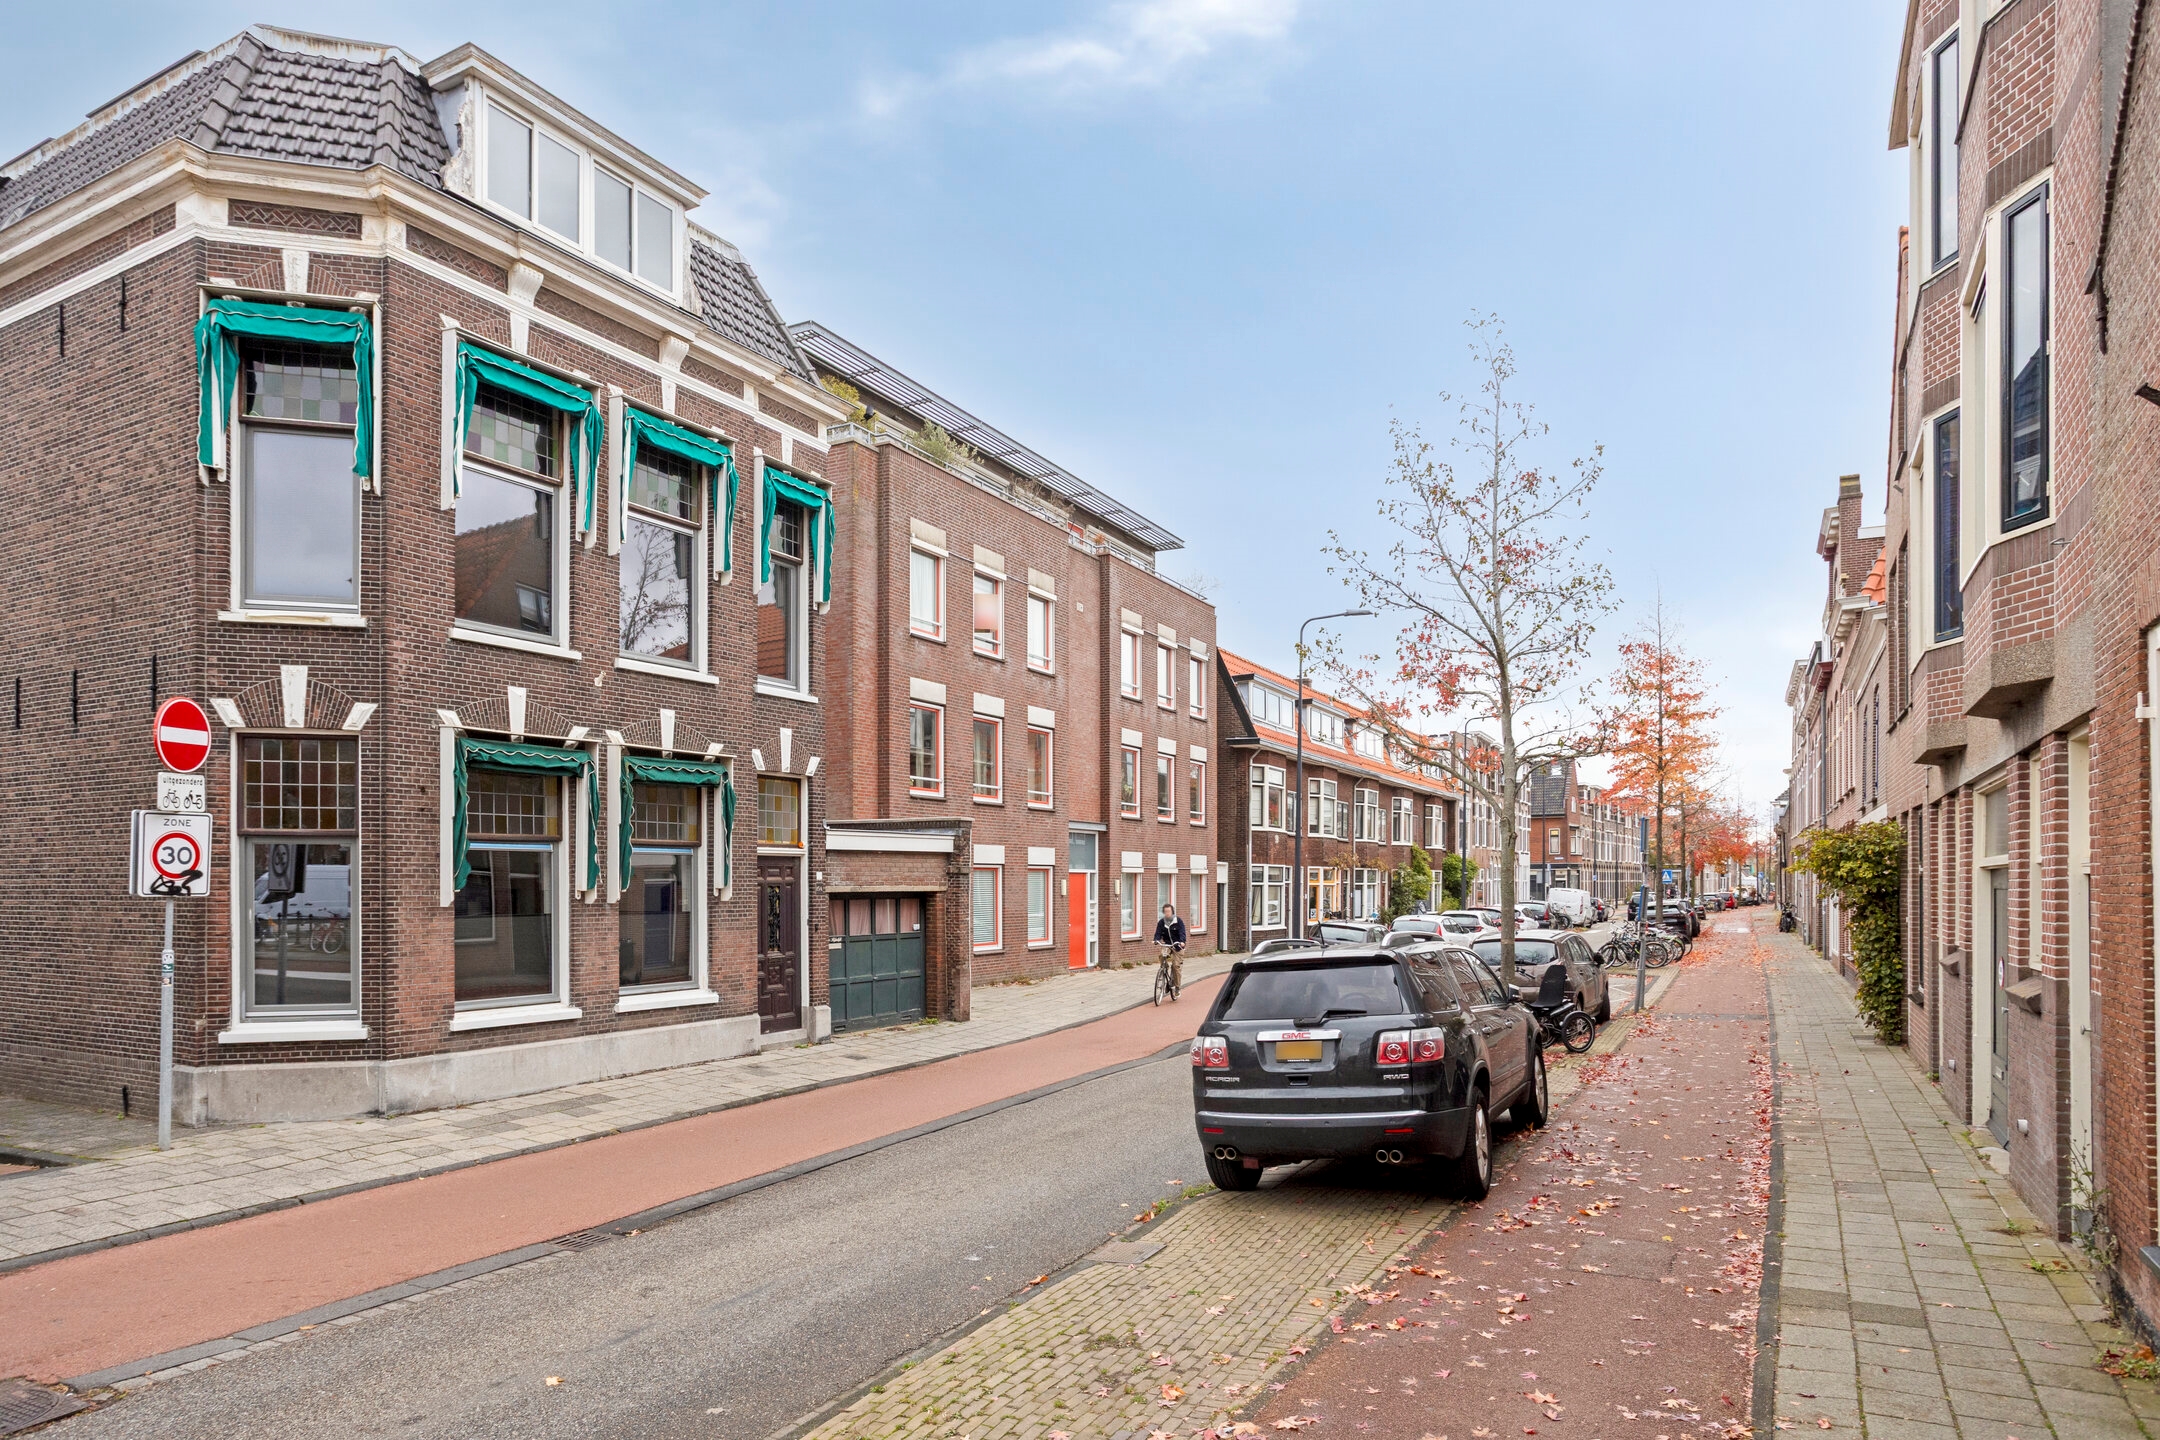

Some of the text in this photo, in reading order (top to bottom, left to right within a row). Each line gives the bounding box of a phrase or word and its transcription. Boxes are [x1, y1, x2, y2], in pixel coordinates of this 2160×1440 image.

[163, 818, 191, 827] ZONE
[160, 846, 192, 865] 30
[1282, 1031, 1312, 1040] GMC
